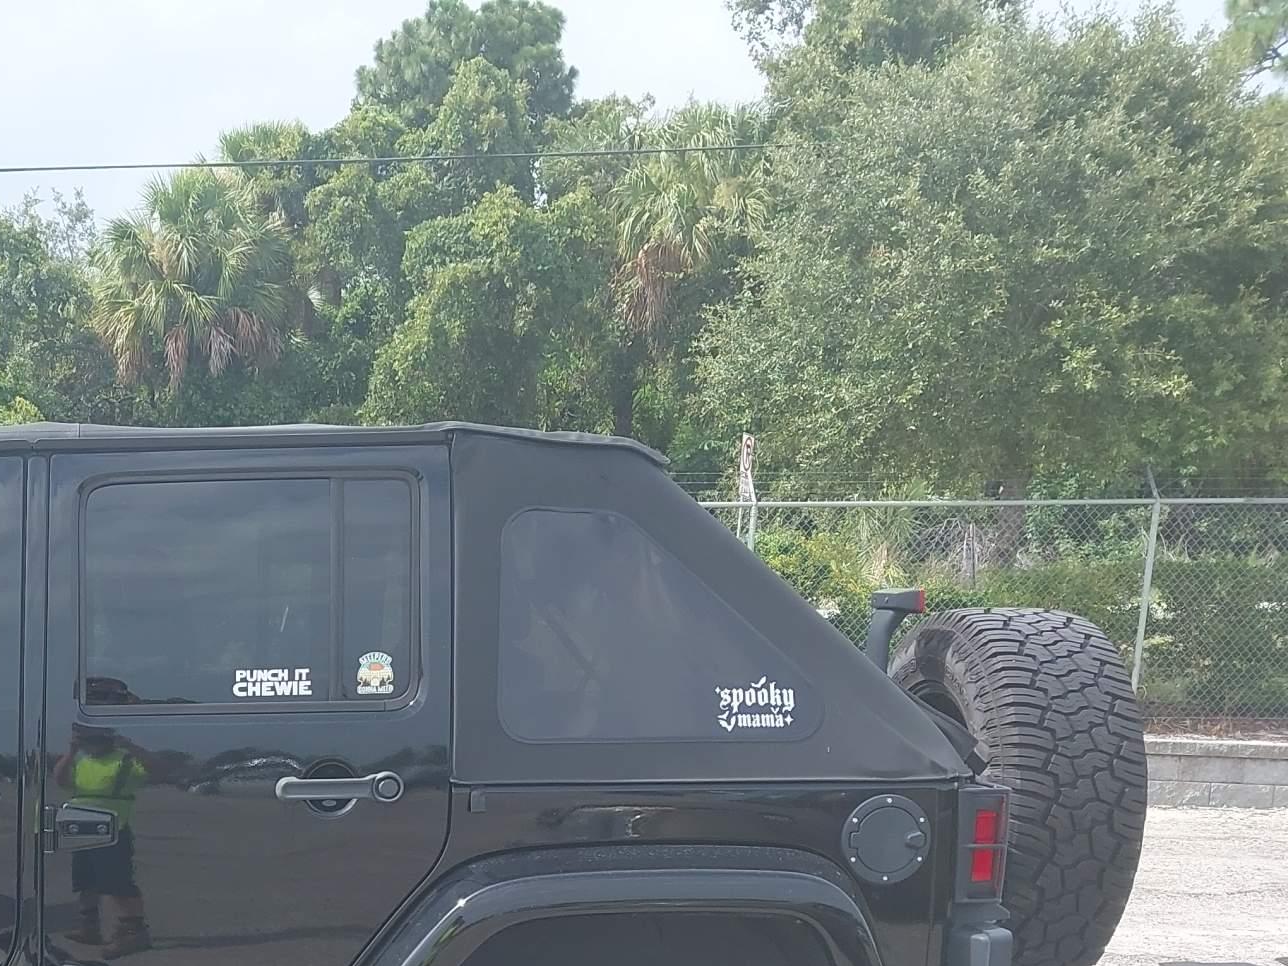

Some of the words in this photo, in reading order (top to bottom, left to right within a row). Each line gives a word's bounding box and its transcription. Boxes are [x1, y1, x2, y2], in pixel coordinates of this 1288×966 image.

[235, 669, 289, 682] PUNCH
[294, 668, 310, 681] IT
[232, 681, 312, 697] CHEWIE
[719, 681, 795, 713] spooky
[737, 713, 784, 728] mama
